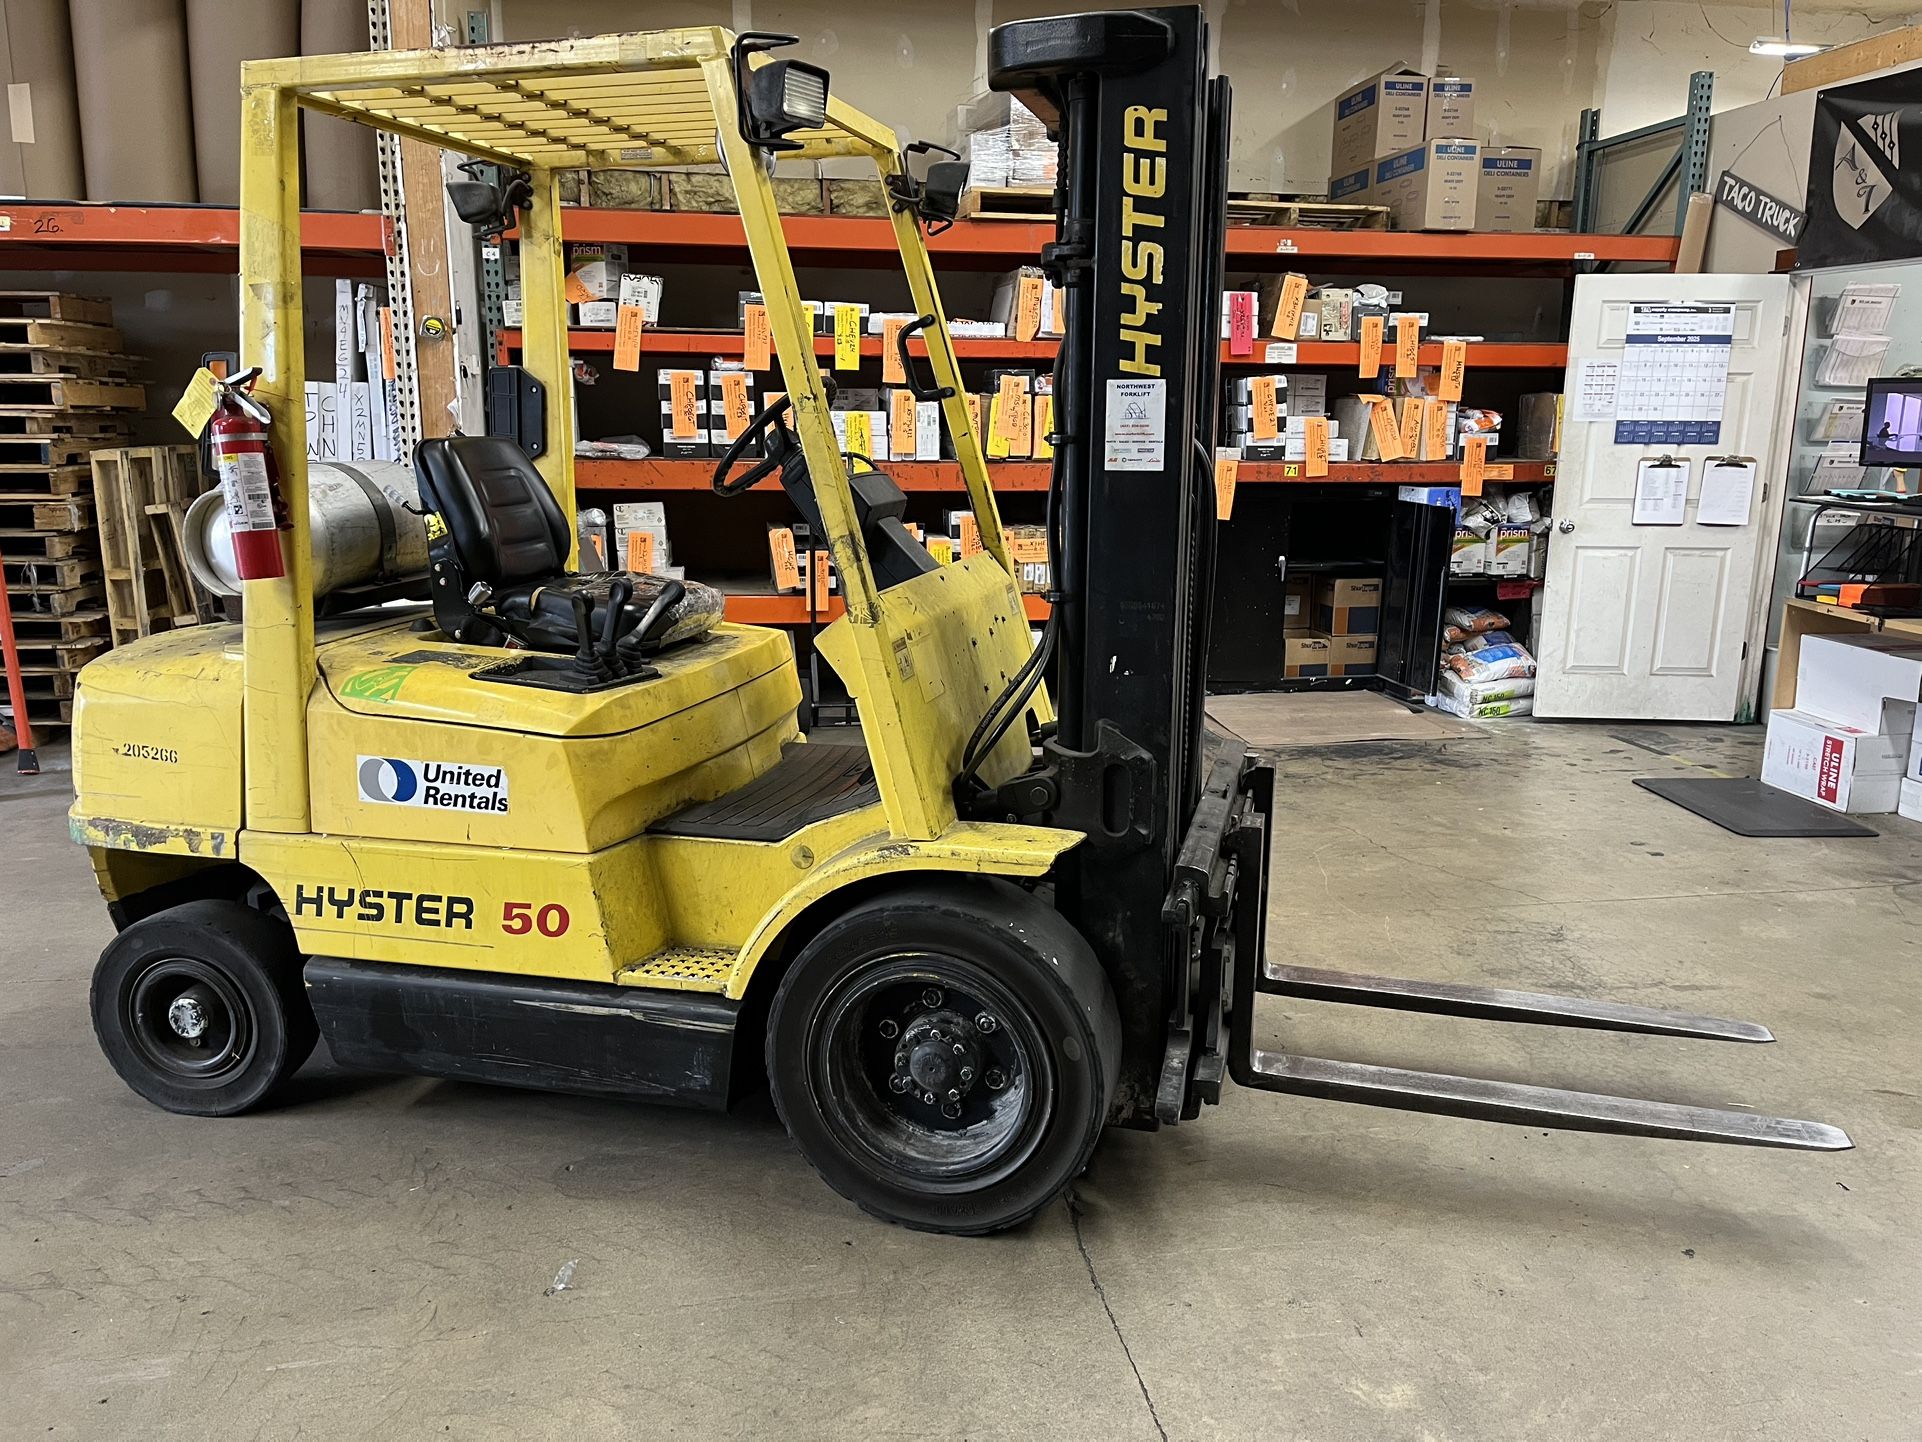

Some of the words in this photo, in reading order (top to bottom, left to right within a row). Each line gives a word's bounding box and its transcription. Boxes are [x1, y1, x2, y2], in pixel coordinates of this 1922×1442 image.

[1395, 82, 1413, 90] ULINE
[1447, 146, 1465, 154] ULINE
[1497, 159, 1518, 168] ULINE
[1496, 170, 1529, 178] CONTAINERS
[1722, 176, 1755, 213] TACO
[1758, 196, 1801, 238] TRUCK
[572, 243, 601, 256] prism
[1119, 105, 1168, 377] HYSTER
[1286, 466, 1297, 475] 71
[1545, 466, 1556, 475] 67
[1500, 529, 1528, 539] prism
[121, 743, 178, 763] 205266
[1821, 739, 1833, 773] STRETCH
[423, 763, 502, 789] United
[1827, 753, 1840, 790] ULINE
[1818, 773, 1828, 796] WRAP
[423, 786, 508, 812] Rentals
[295, 884, 474, 930] HYSTER
[501, 901, 570, 938] 50
